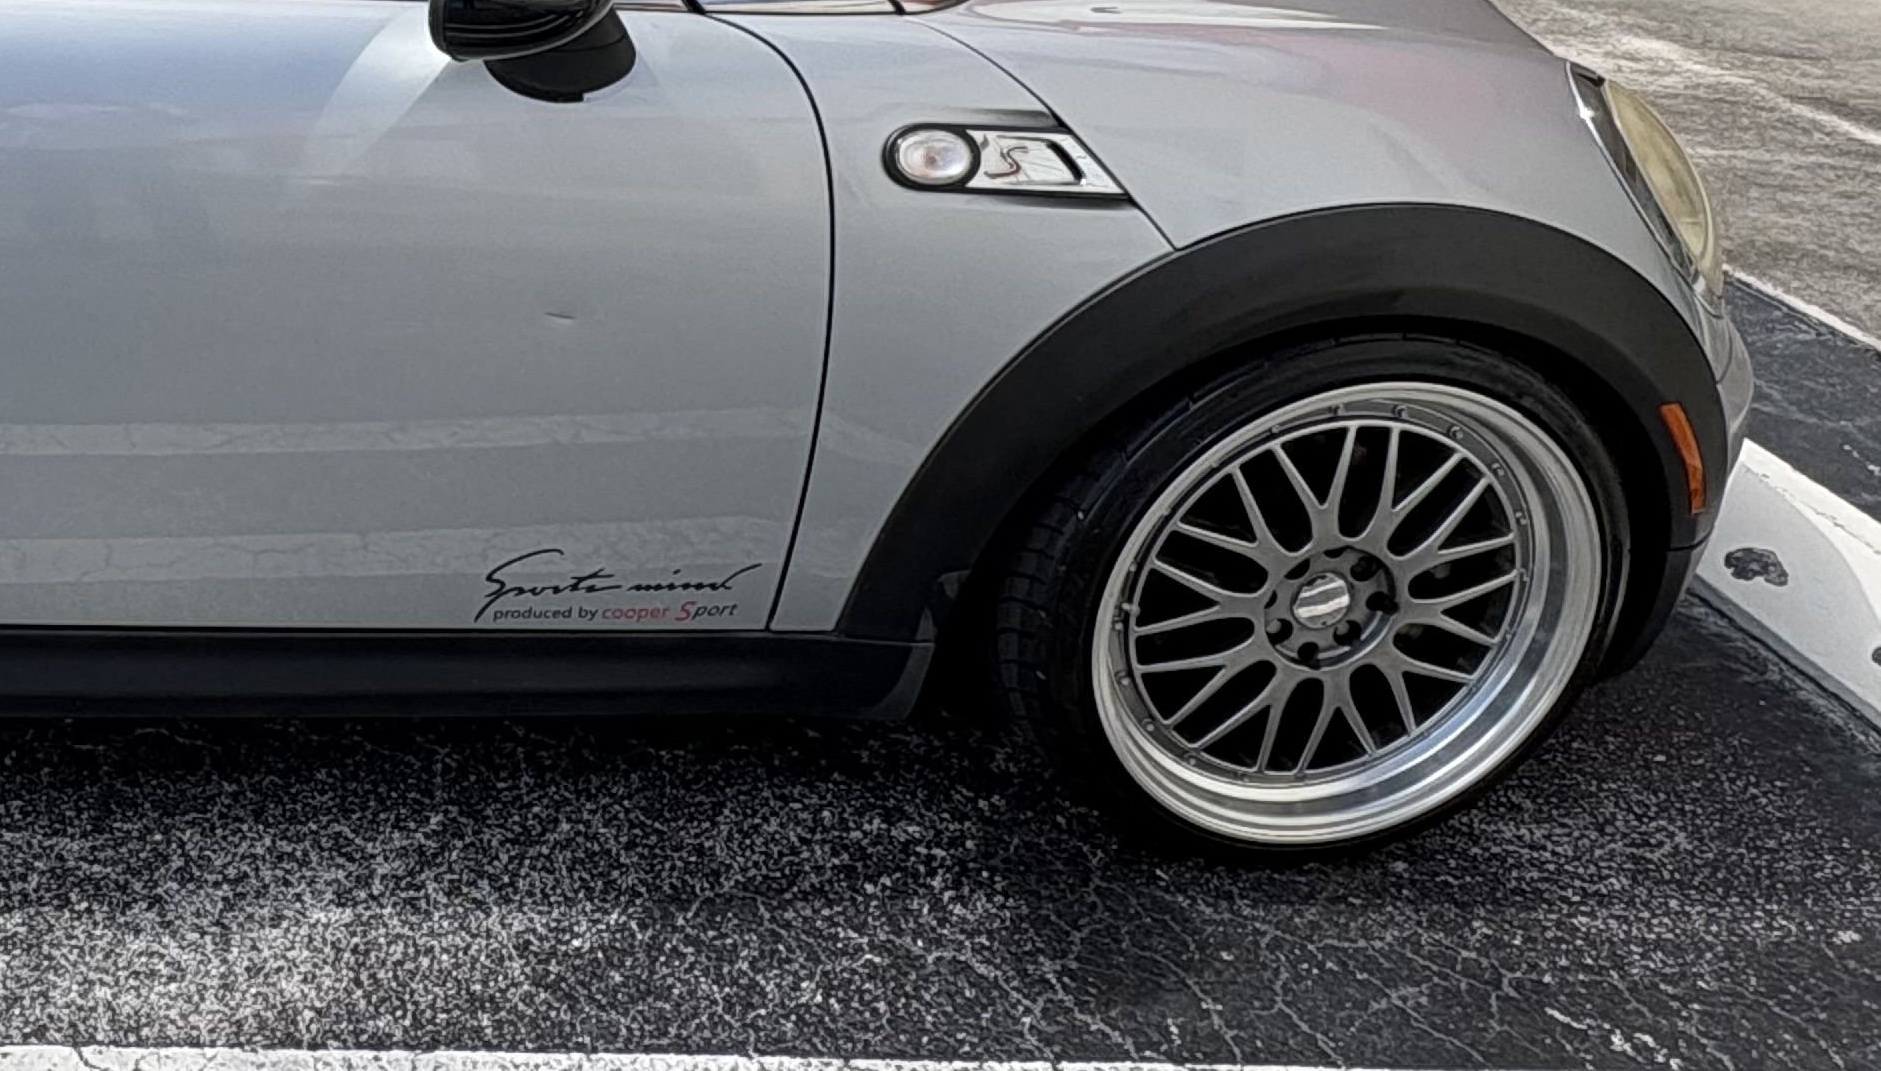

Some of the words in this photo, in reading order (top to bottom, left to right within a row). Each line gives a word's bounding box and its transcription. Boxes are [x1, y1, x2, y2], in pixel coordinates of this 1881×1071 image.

[492, 606, 573, 622] produced
[578, 606, 599, 621] by
[601, 606, 670, 622] cooper
[674, 600, 739, 622] Sport
